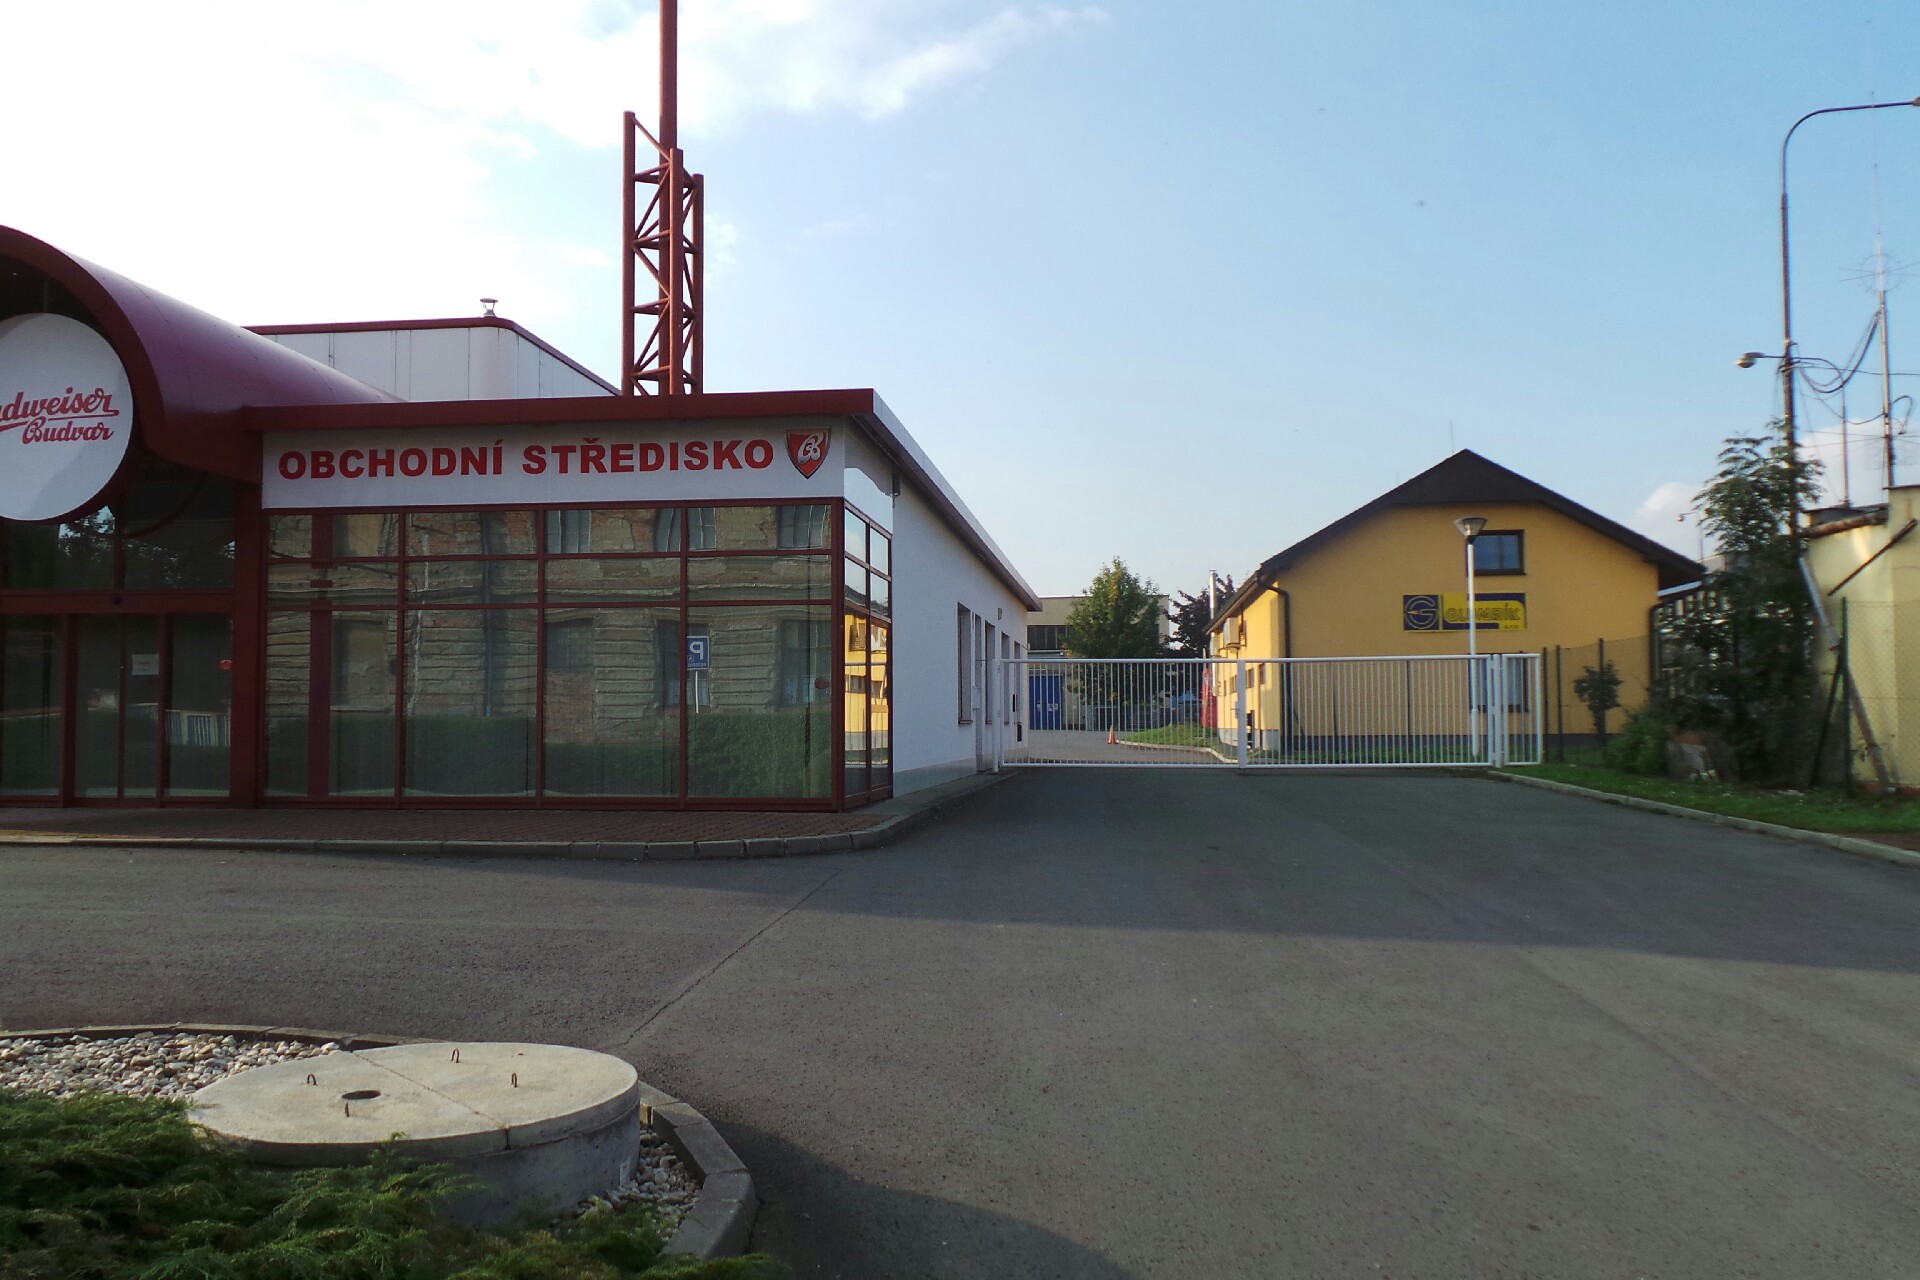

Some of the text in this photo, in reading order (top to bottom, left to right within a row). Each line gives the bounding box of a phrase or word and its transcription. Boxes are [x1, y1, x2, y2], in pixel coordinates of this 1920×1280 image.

[0, 387, 119, 422] dweiser
[22, 416, 114, 444] Budvar
[280, 437, 774, 480] OBCHODNÍ STŘEDISKO
